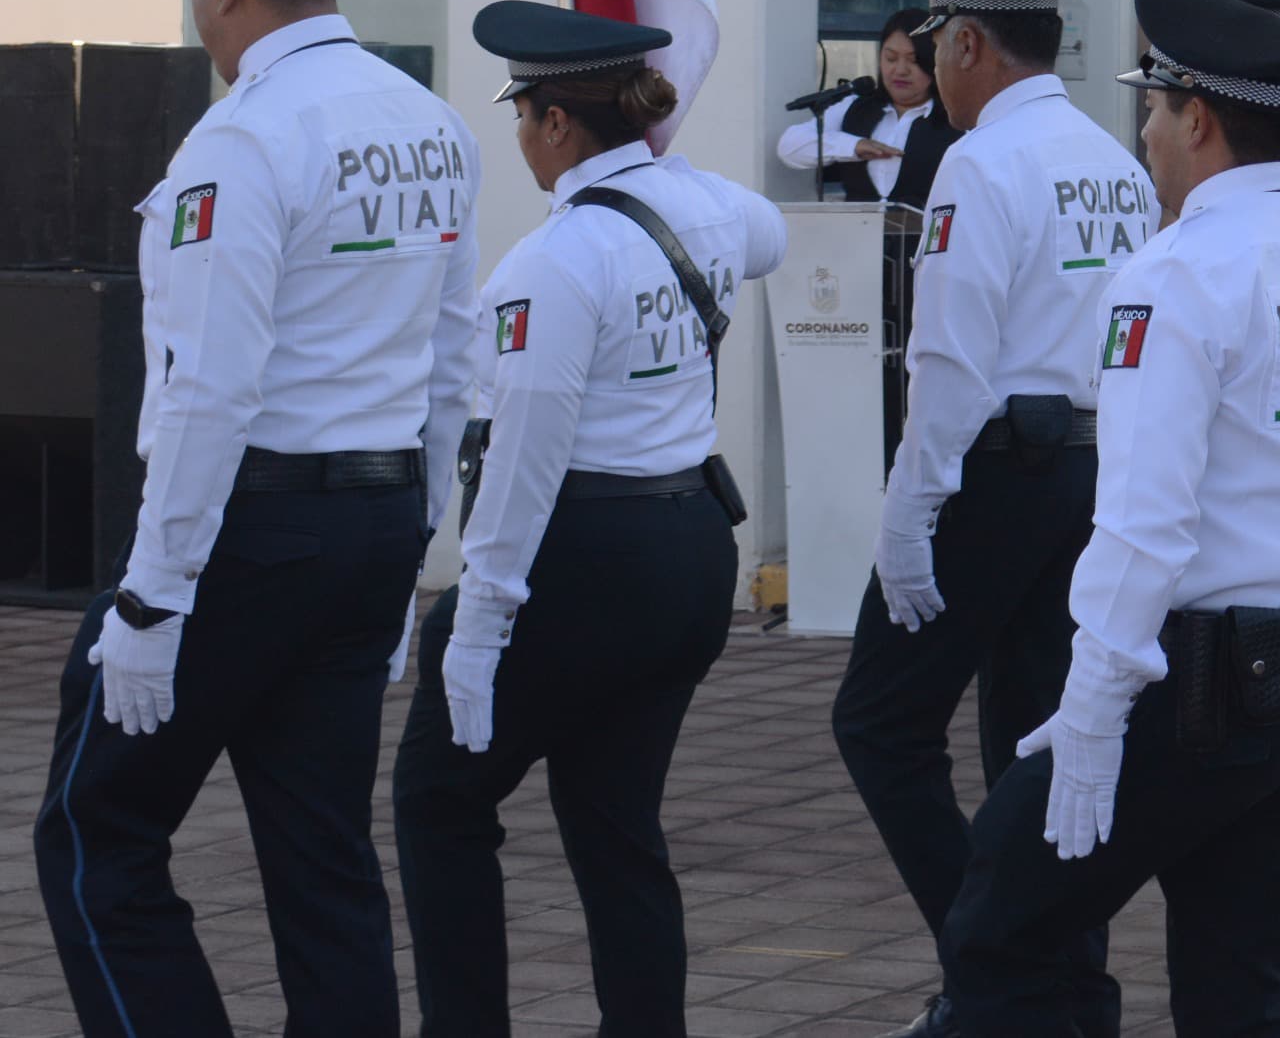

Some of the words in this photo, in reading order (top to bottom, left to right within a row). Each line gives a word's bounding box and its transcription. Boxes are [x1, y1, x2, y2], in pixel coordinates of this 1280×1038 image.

[337, 127, 465, 193] POLICÍA
[360, 188, 459, 236] VIAL
[785, 322, 870, 334] CORONANGO
[1112, 306, 1148, 321] MÉXICO
[650, 316, 706, 364] VIA
